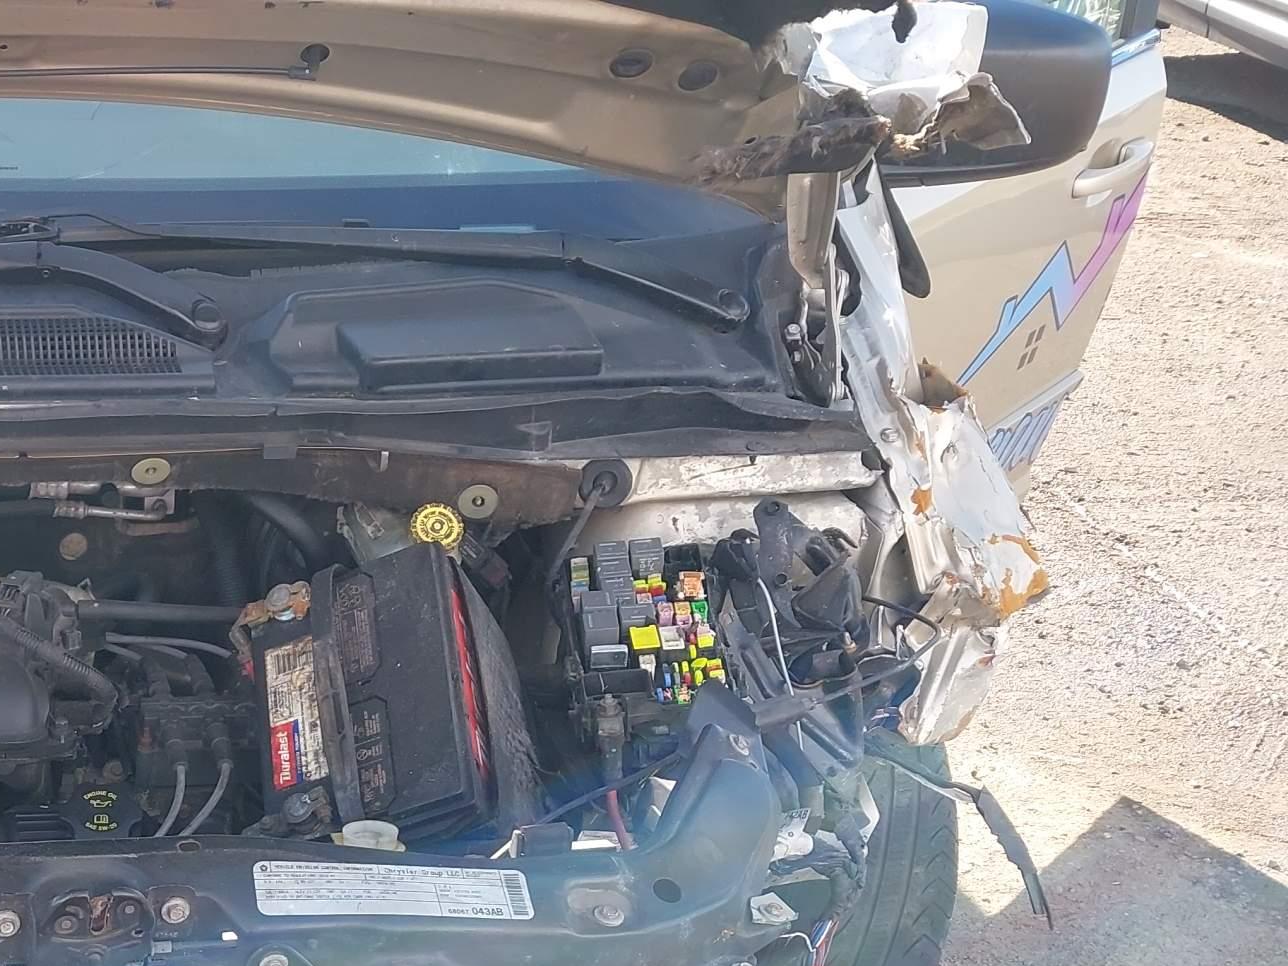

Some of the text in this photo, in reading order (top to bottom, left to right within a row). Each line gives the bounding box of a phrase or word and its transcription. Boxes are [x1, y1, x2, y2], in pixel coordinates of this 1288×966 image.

[275, 730, 292, 784] Duralast
[84, 791, 107, 800] ENGINE
[471, 907, 504, 916] 043AB
